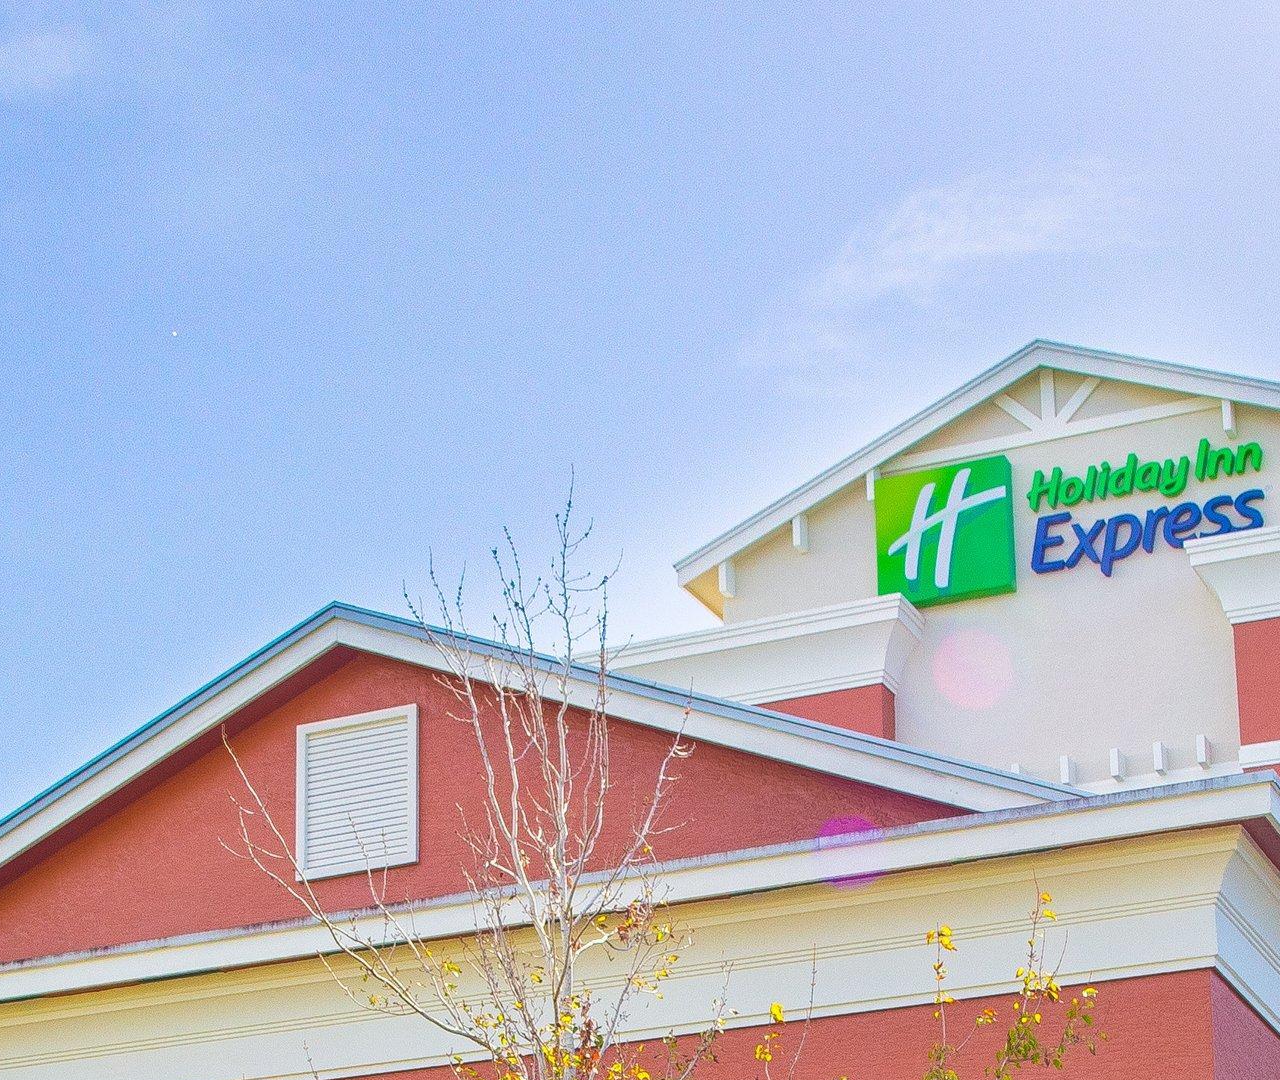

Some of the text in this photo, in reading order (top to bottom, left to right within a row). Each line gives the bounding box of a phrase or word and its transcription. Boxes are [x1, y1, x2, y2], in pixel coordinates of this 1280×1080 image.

[1026, 437, 1264, 512] Holiday Inn
[1030, 487, 1266, 577] Express
